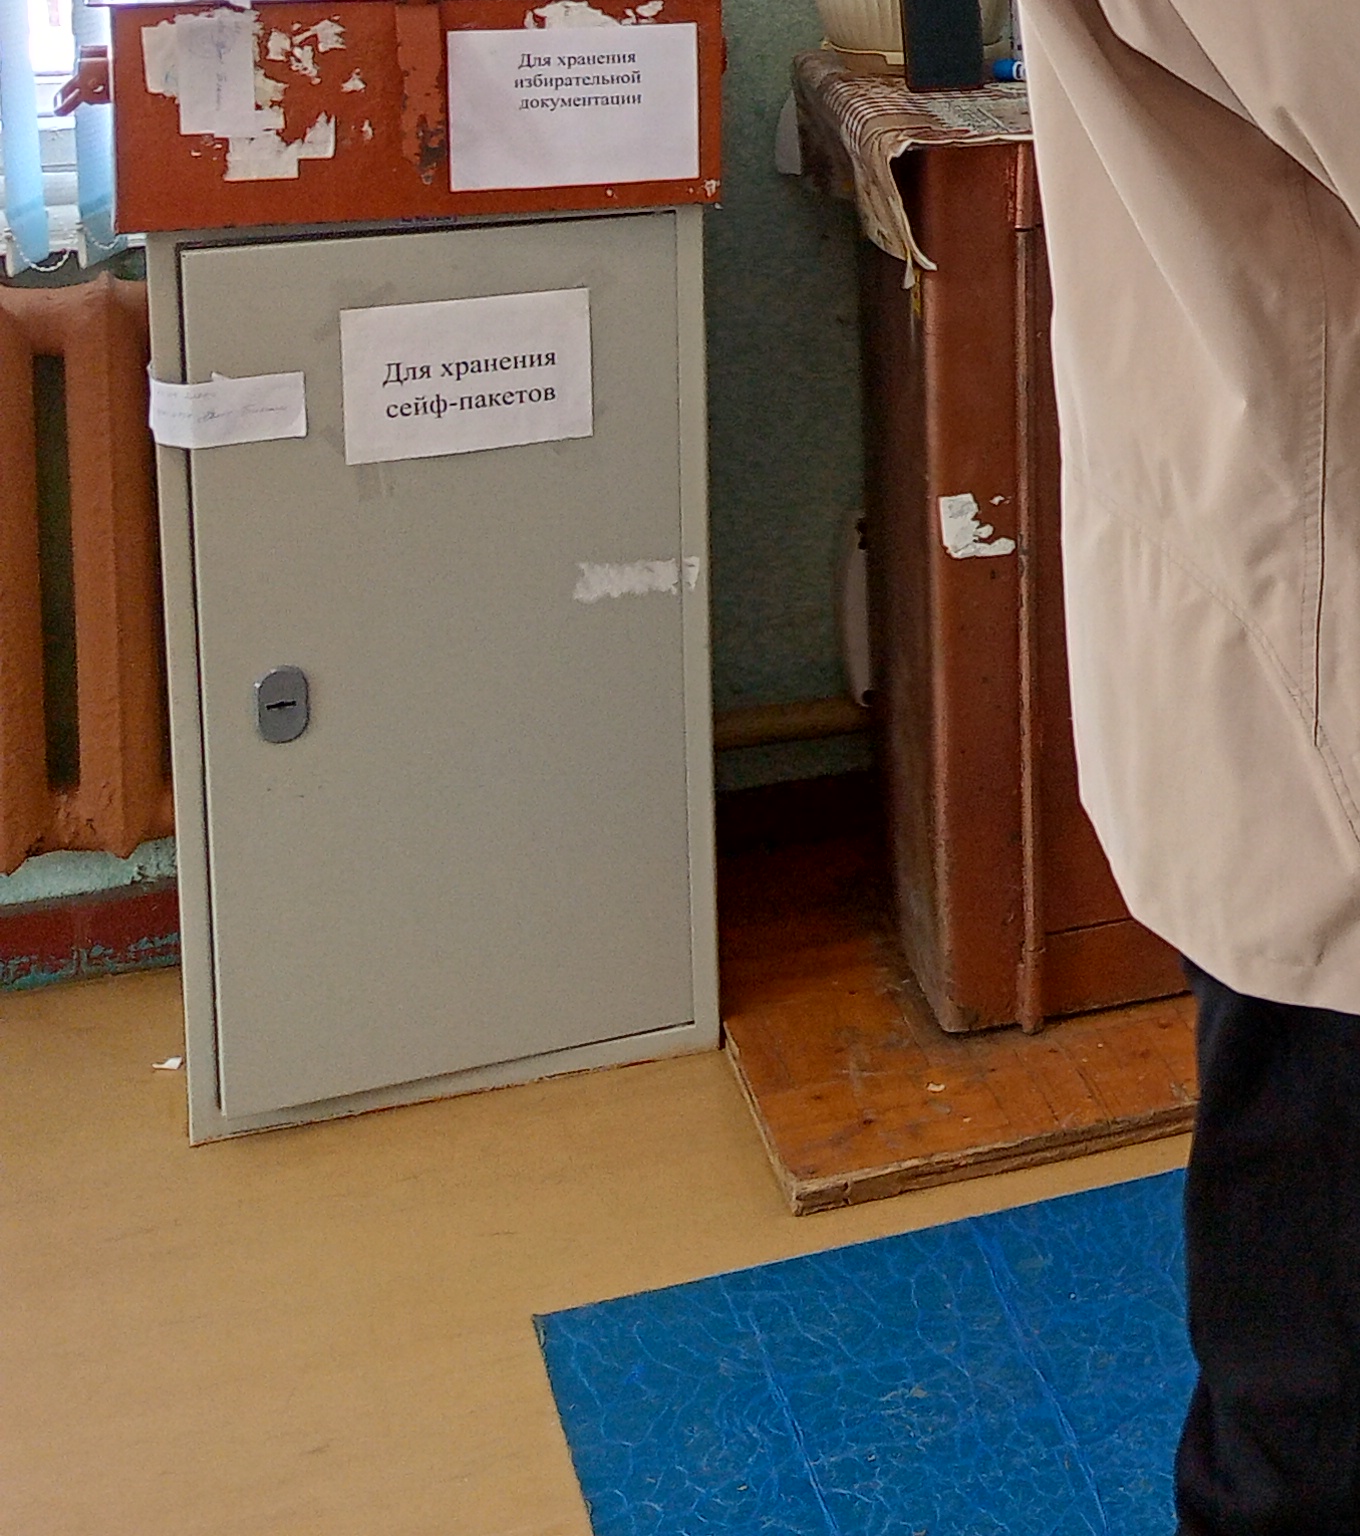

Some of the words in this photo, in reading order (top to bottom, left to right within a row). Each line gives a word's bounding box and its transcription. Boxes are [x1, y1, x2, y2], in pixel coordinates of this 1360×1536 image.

[517, 53, 551, 70] Для
[557, 52, 637, 70] хранения
[514, 70, 641, 91] избирательной
[518, 93, 642, 112] документации
[382, 362, 432, 388] Для
[440, 351, 557, 381] хранения
[386, 385, 556, 419] сейф-пакетов
